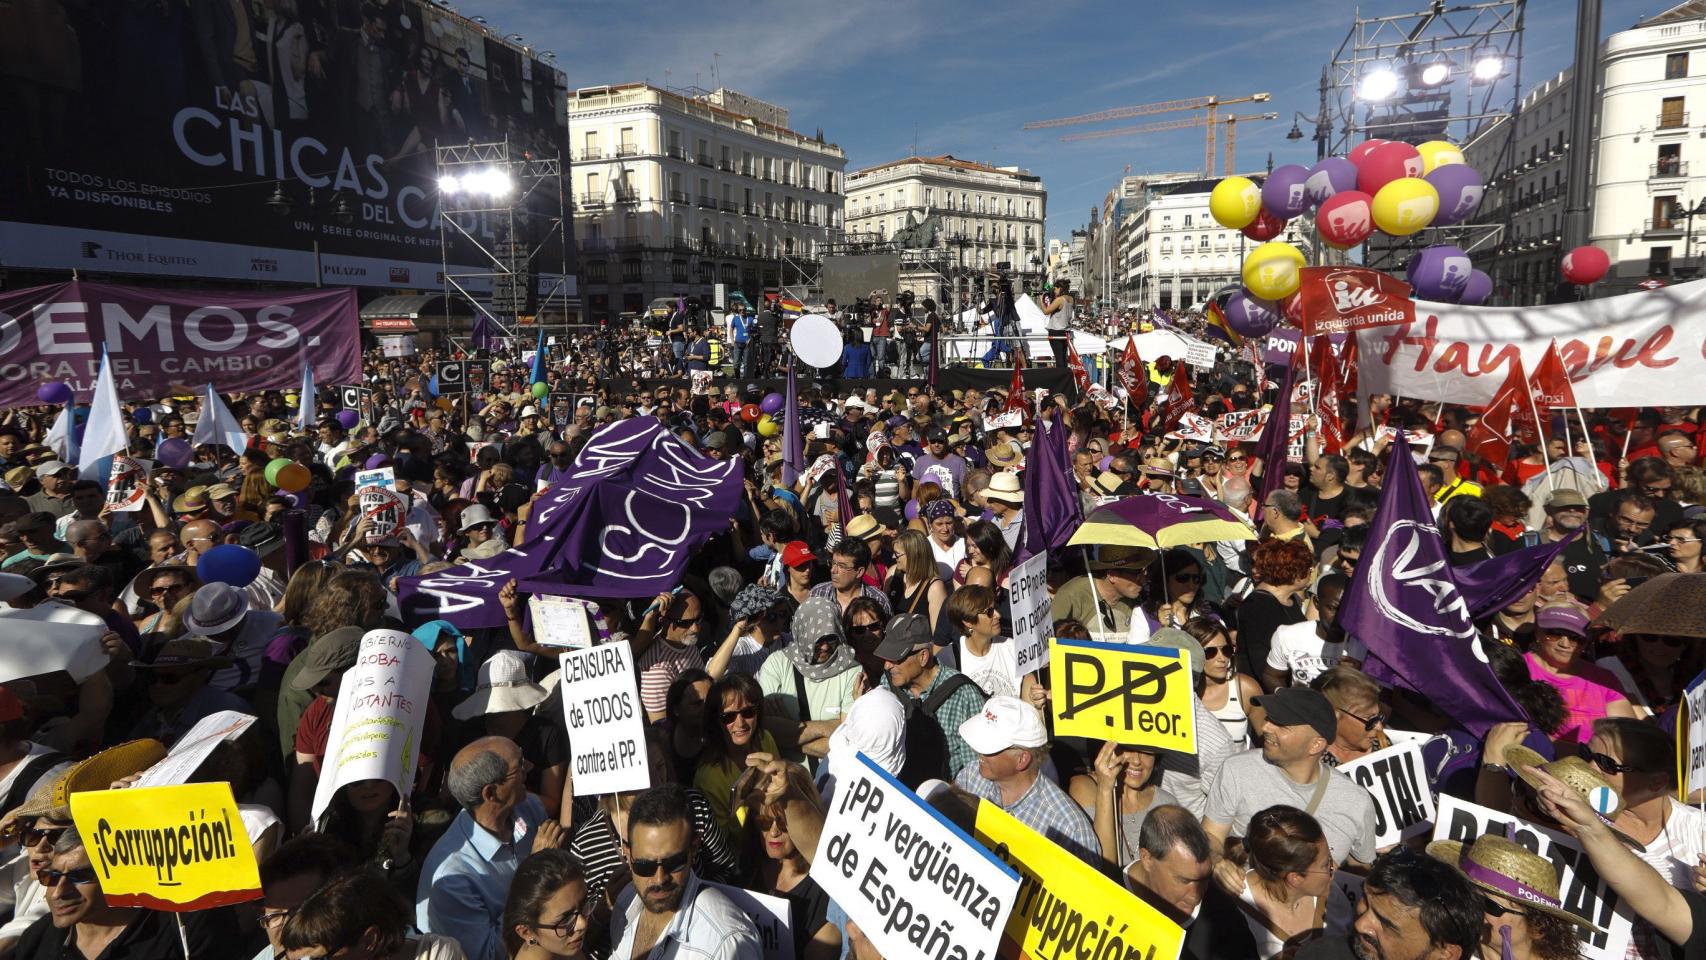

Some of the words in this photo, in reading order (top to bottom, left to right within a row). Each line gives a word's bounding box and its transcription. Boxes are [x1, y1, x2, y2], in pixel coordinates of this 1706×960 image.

[216, 86, 258, 118] LAS
[173, 106, 389, 199] CHICAS
[46, 168, 103, 187] TODOS
[108, 179, 136, 192] LOS
[141, 184, 212, 204] EPISODIOS
[47, 185, 69, 198] YA
[75, 190, 173, 213] DISPONIBLES
[362, 202, 394, 224] DEL
[396, 185, 496, 239] CABL
[294, 220, 315, 232] UN
[322, 225, 352, 237] SERIE
[355, 229, 401, 243] ORIGINAL
[404, 236, 416, 245] DE
[419, 237, 453, 249] NETFX
[107, 248, 144, 263] THOR
[147, 252, 200, 266] EQUITIES
[323, 265, 367, 277] PALAZZO
[1314, 316, 1365, 331] izquierda
[1366, 309, 1405, 324] unida
[160, 354, 273, 374] CAMBIO
[41, 377, 136, 392] ÁLAA
[1011, 581, 1020, 605] El
[1021, 575, 1033, 600] PP
[1015, 616, 1027, 636] un
[564, 646, 626, 684] CENSURA
[1017, 648, 1028, 666] es
[384, 675, 396, 687] A
[569, 702, 584, 729] de
[584, 691, 633, 725] TODOS
[576, 747, 606, 775] contra
[608, 743, 618, 771] el
[1350, 750, 1428, 838] STA!
[93, 807, 236, 882] ¡Corruppción!
[826, 832, 859, 879] de
[839, 776, 884, 837] ¡PP,
[884, 811, 1001, 932] vergüenza
[1518, 886, 1562, 909] PODEMO
